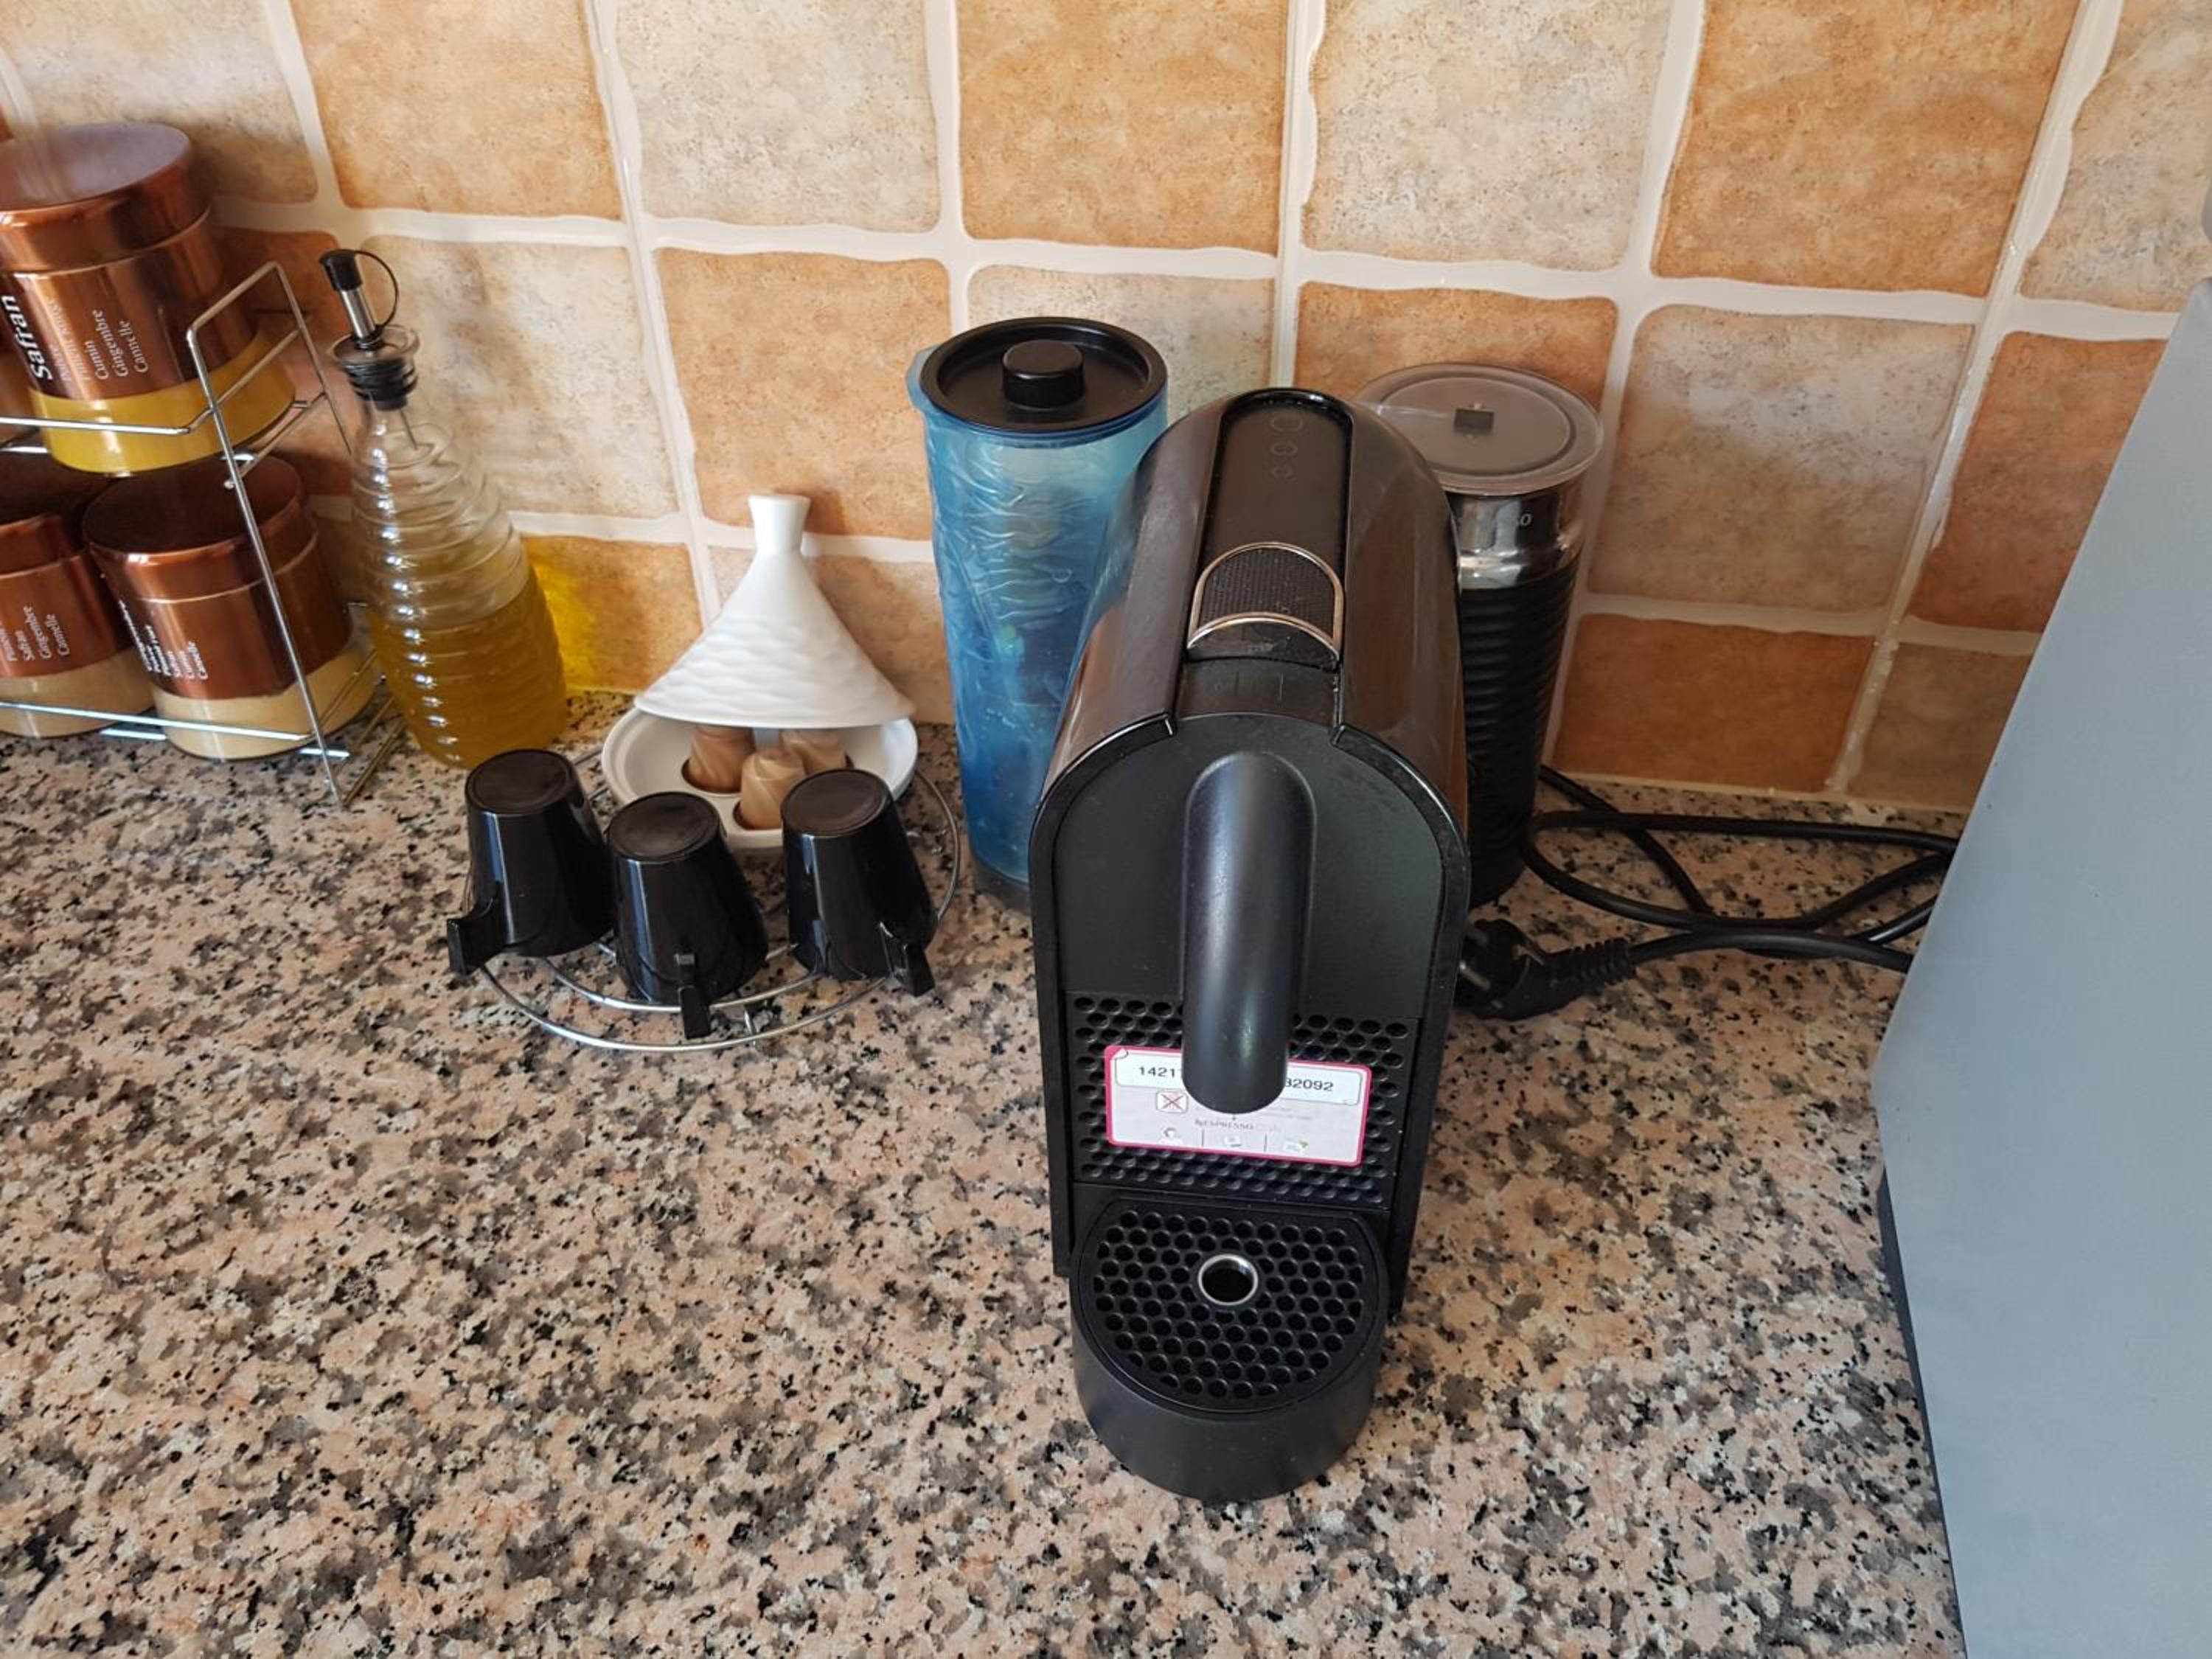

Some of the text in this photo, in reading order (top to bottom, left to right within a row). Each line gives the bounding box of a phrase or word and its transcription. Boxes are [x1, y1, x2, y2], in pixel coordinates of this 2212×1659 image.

[1, 295, 53, 380] Safran
[85, 340, 109, 380] Cumin
[92, 310, 129, 377] Gingembre
[119, 320, 148, 373] Cannelle
[1139, 1066, 1180, 1078] 1421
